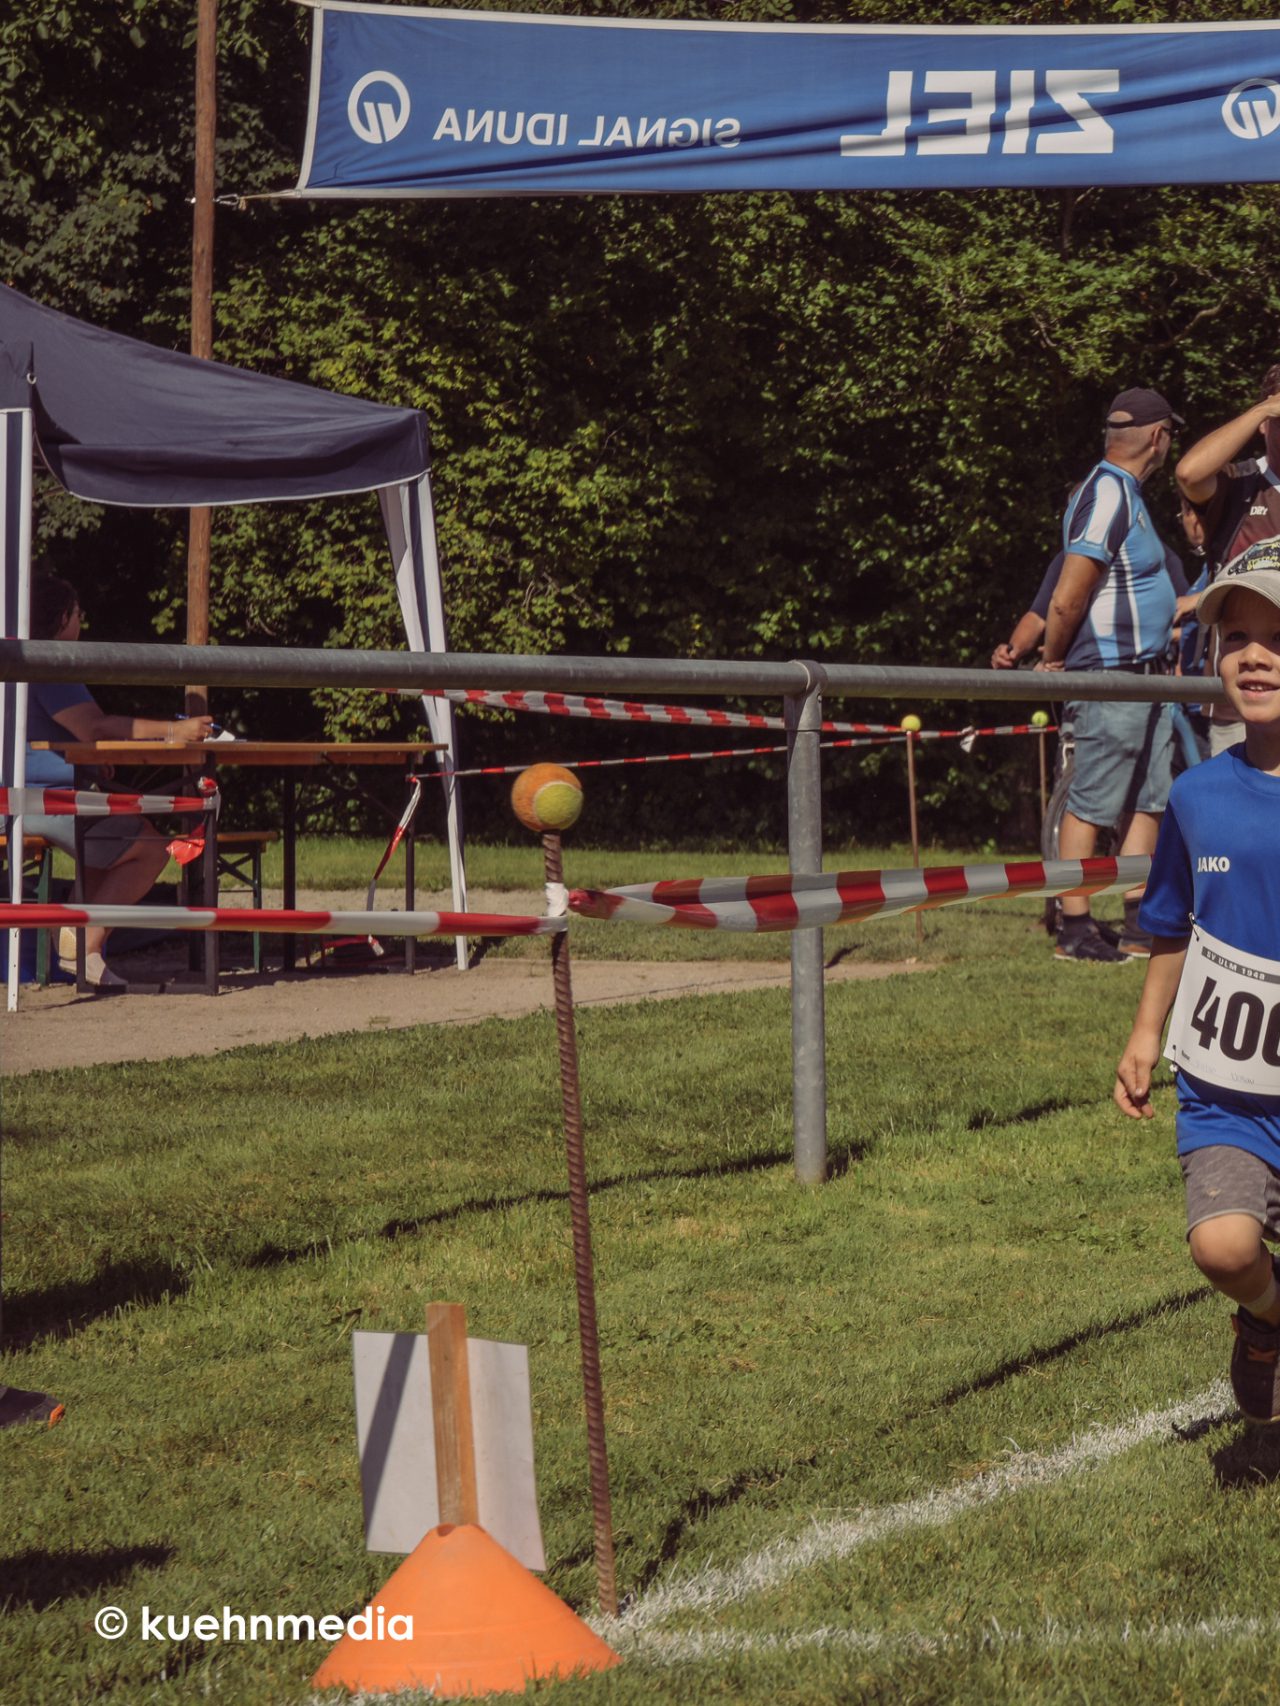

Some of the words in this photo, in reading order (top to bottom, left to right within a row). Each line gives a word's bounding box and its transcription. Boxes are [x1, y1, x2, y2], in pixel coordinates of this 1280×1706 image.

[1197, 856, 1231, 873] JAKO
[1206, 950, 1217, 961] SV
[1218, 958, 1238, 972] ULM
[1241, 967, 1266, 981] 1948
